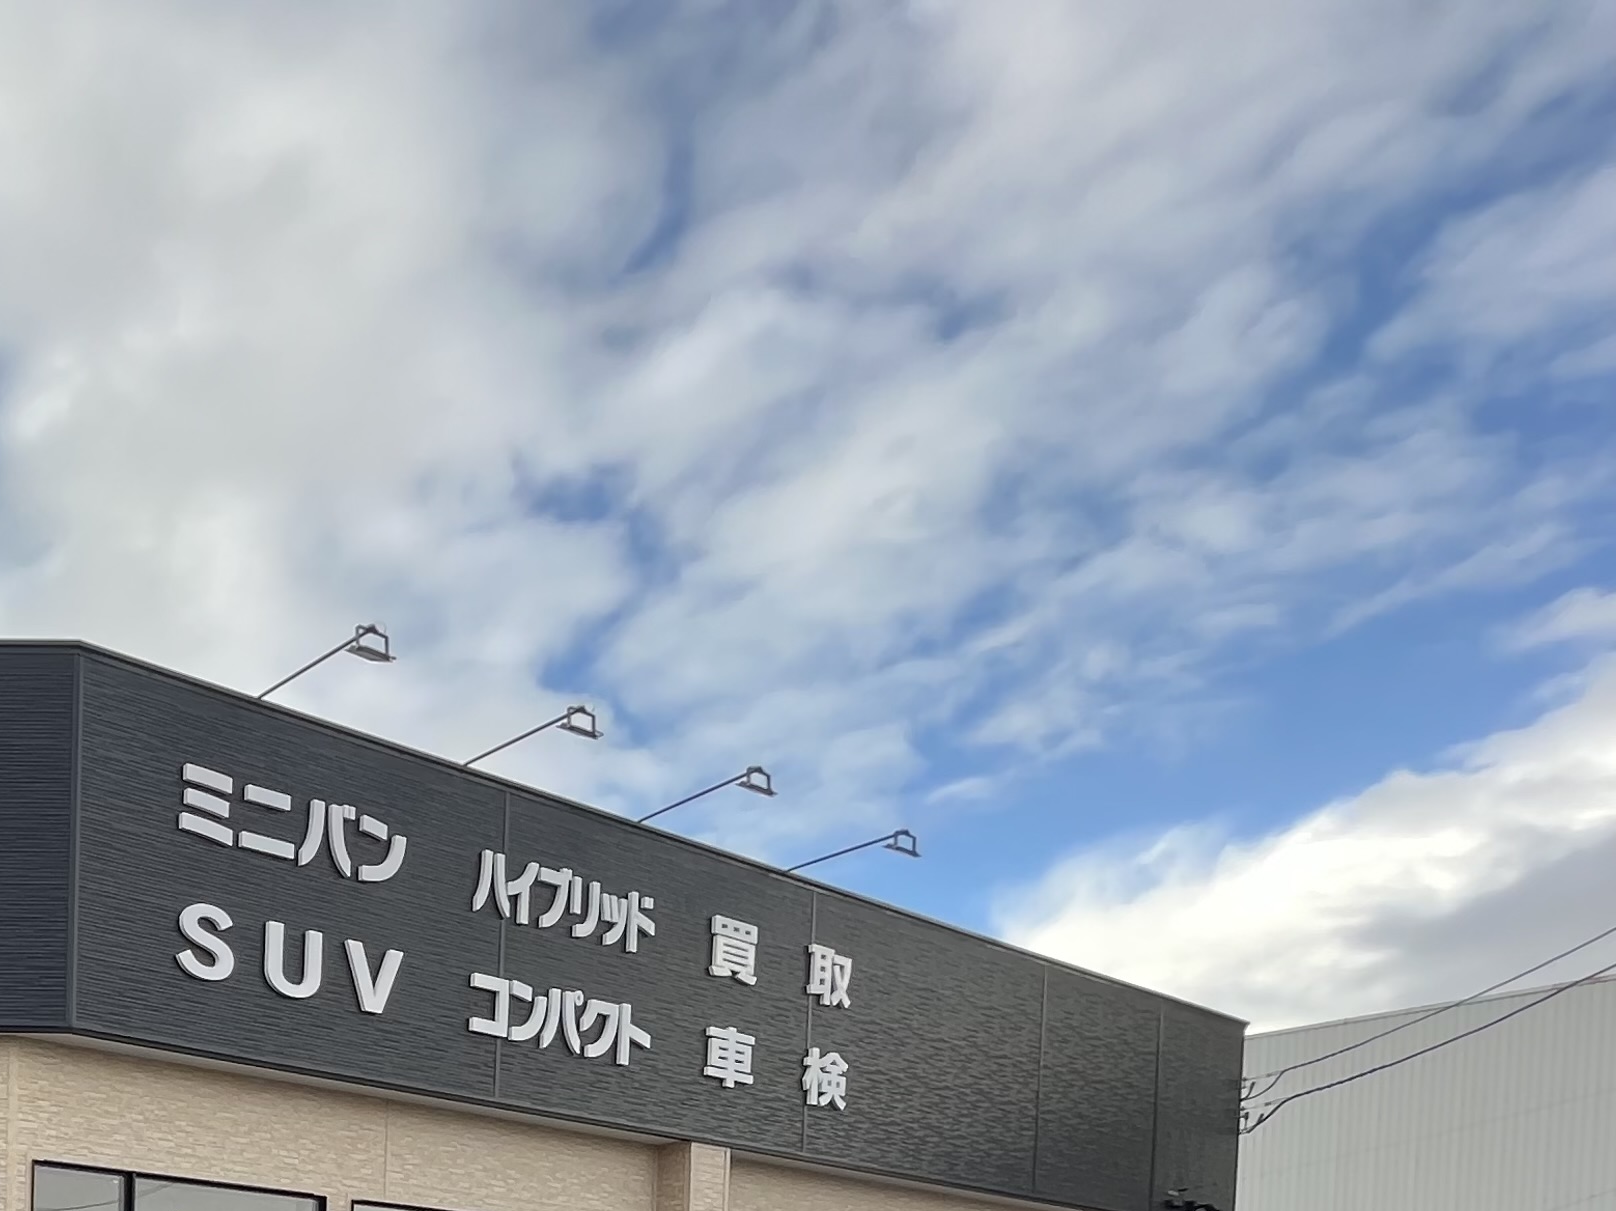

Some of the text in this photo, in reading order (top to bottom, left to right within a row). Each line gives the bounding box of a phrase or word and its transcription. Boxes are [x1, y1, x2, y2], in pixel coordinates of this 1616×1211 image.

[179, 762, 407, 882] ミニバン
[473, 848, 655, 953] ハイブリッド
[175, 902, 405, 1014] SUV
[708, 914, 853, 1009] 買取
[468, 972, 651, 1066] コンパクト
[704, 1026, 850, 1110] 車検
